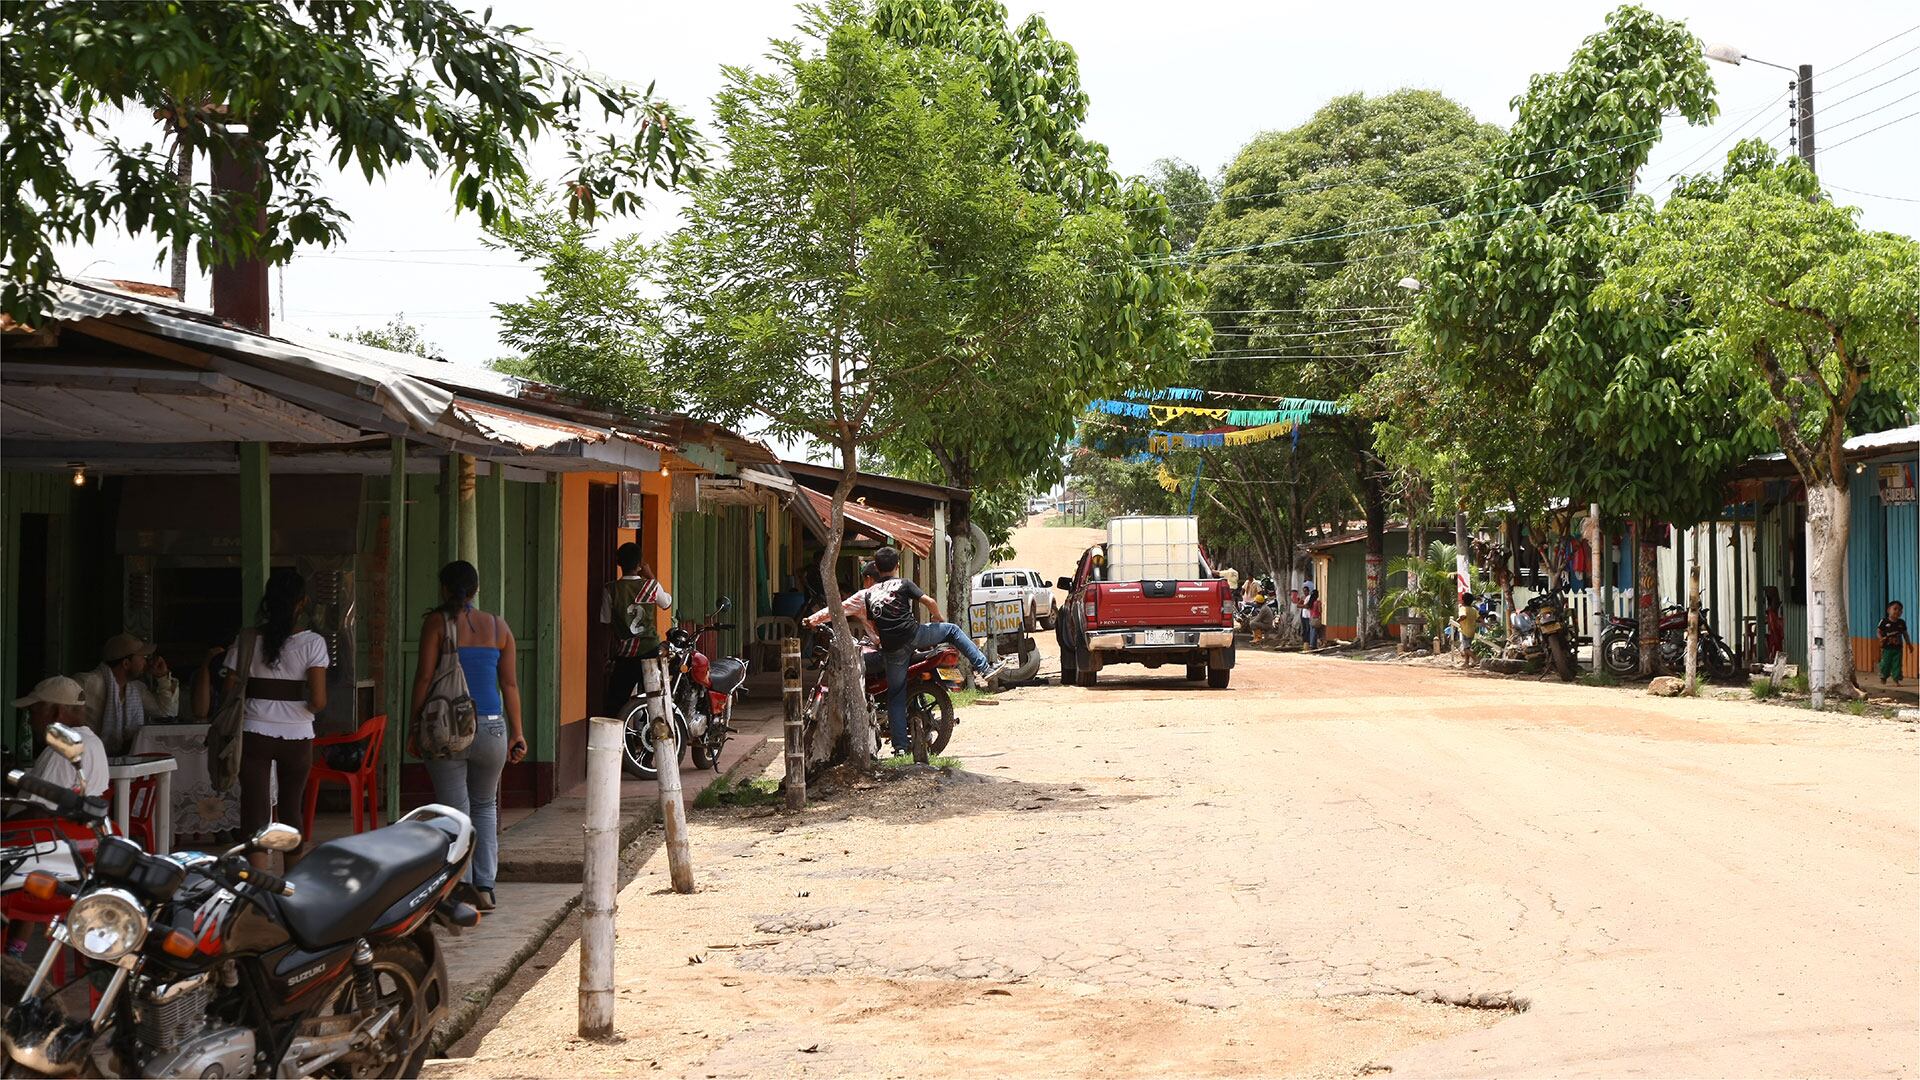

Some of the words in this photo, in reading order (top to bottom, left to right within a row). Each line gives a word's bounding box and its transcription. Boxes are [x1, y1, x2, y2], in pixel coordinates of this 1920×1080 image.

[627, 604, 646, 635] 2
[973, 605, 1005, 618] VETA
[1006, 603, 1020, 615] DE
[972, 617, 1022, 632] GAOLINA
[288, 963, 326, 986] SUZUKI
